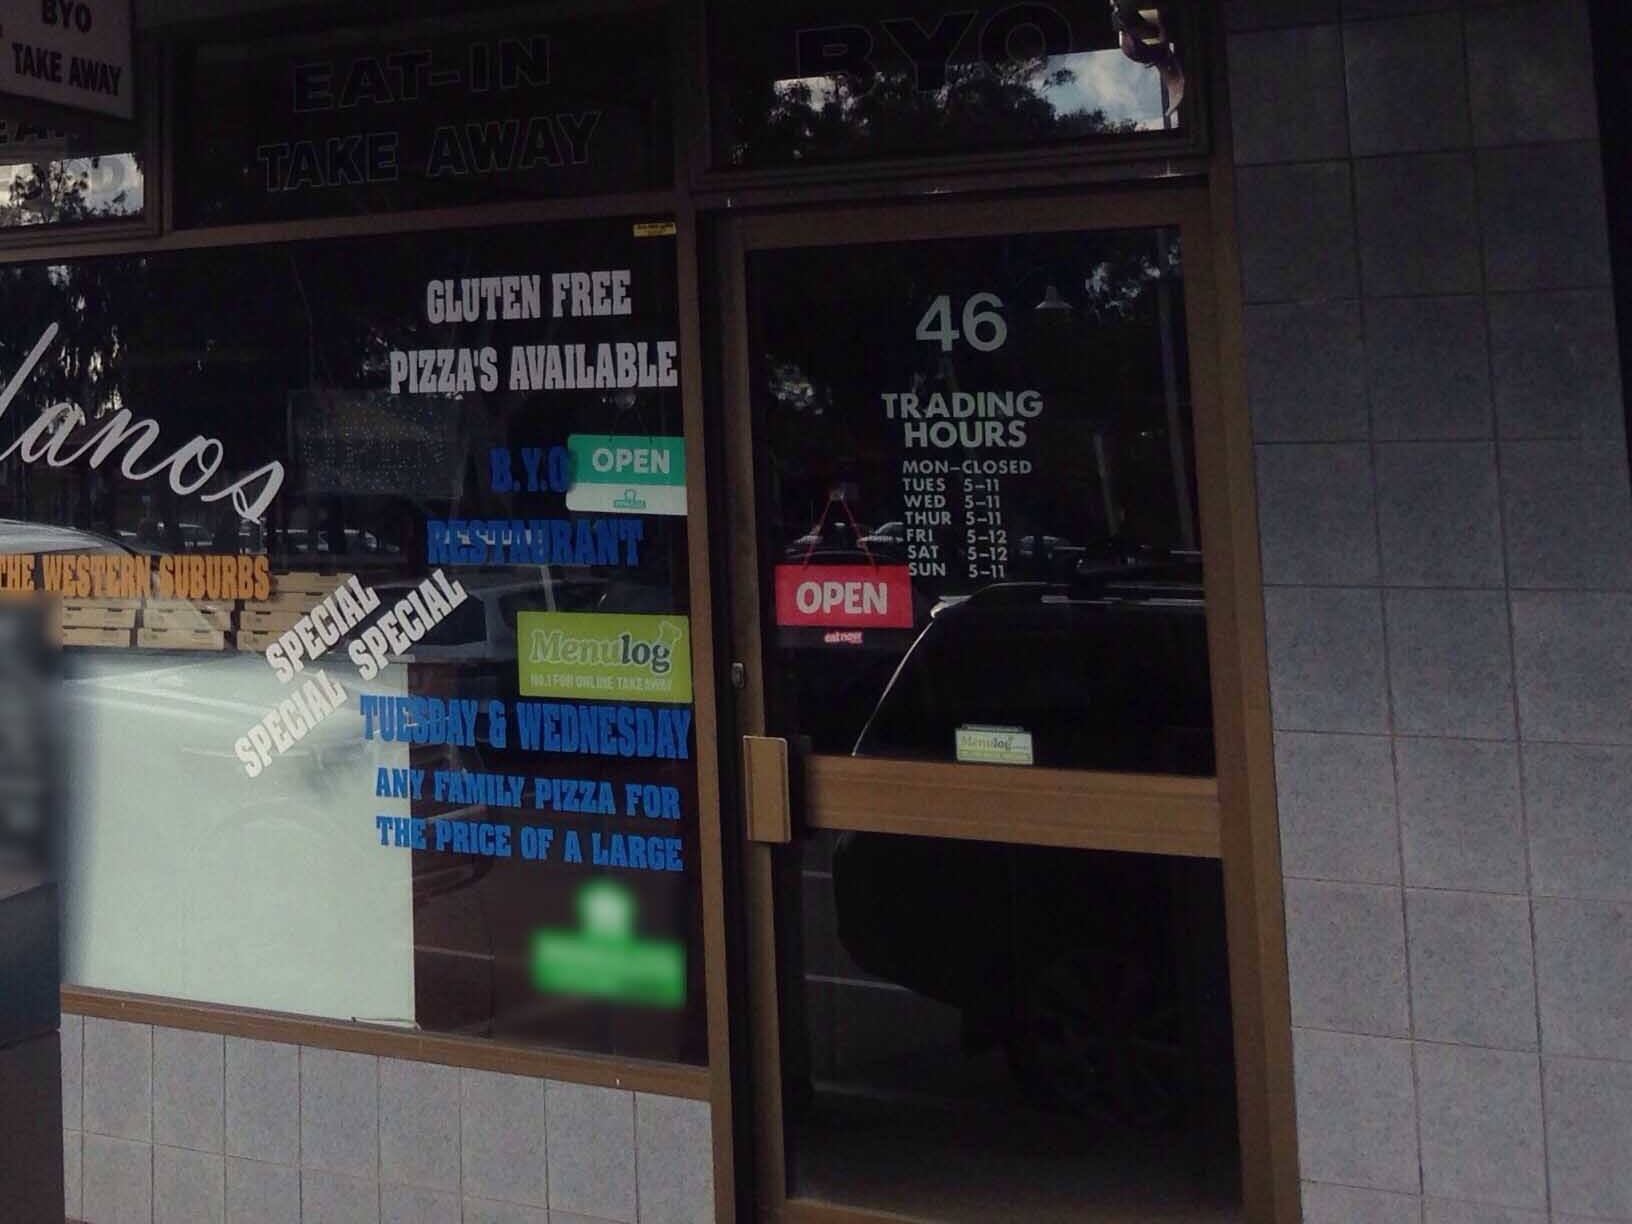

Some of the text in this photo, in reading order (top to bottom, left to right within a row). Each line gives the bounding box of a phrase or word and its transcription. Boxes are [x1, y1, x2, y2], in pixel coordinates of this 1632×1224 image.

[12, 42, 121, 96] TAKE AWAY
[293, 35, 551, 113] EAT-IN
[258, 111, 602, 192] TAKE AWAY
[427, 270, 632, 324] GLUTEN FREE
[916, 292, 1008, 352] 46
[390, 341, 678, 394] PIZZA'S AVAILABLE
[881, 390, 1044, 419] TRADING
[904, 421, 1027, 448] HOURS
[591, 447, 670, 474] OPEN
[902, 478, 1000, 492] TUES 5-11
[904, 495, 1001, 509] WED 5-11
[905, 511, 1002, 526] THUR 5-11
[426, 518, 644, 567] RESTAURANT
[906, 528, 1008, 544] FRI 5-12
[907, 545, 1008, 561] SAT 5-12
[42, 554, 152, 600] WESTERN
[159, 554, 268, 601] SUBURBS
[908, 562, 1005, 578] SUN 5-11
[795, 580, 888, 615] OPEN
[266, 575, 381, 684] SPECIAL
[348, 568, 468, 680] SPECIAL
[529, 629, 671, 674] Menulog
[234, 669, 348, 778] SPECIAL
[360, 694, 691, 759] TUESDAY & WEDNESDAY
[376, 767, 681, 820] ANY FAMILY PIZZA FOR
[376, 815, 683, 871] THE PRICE OF A LARGE
